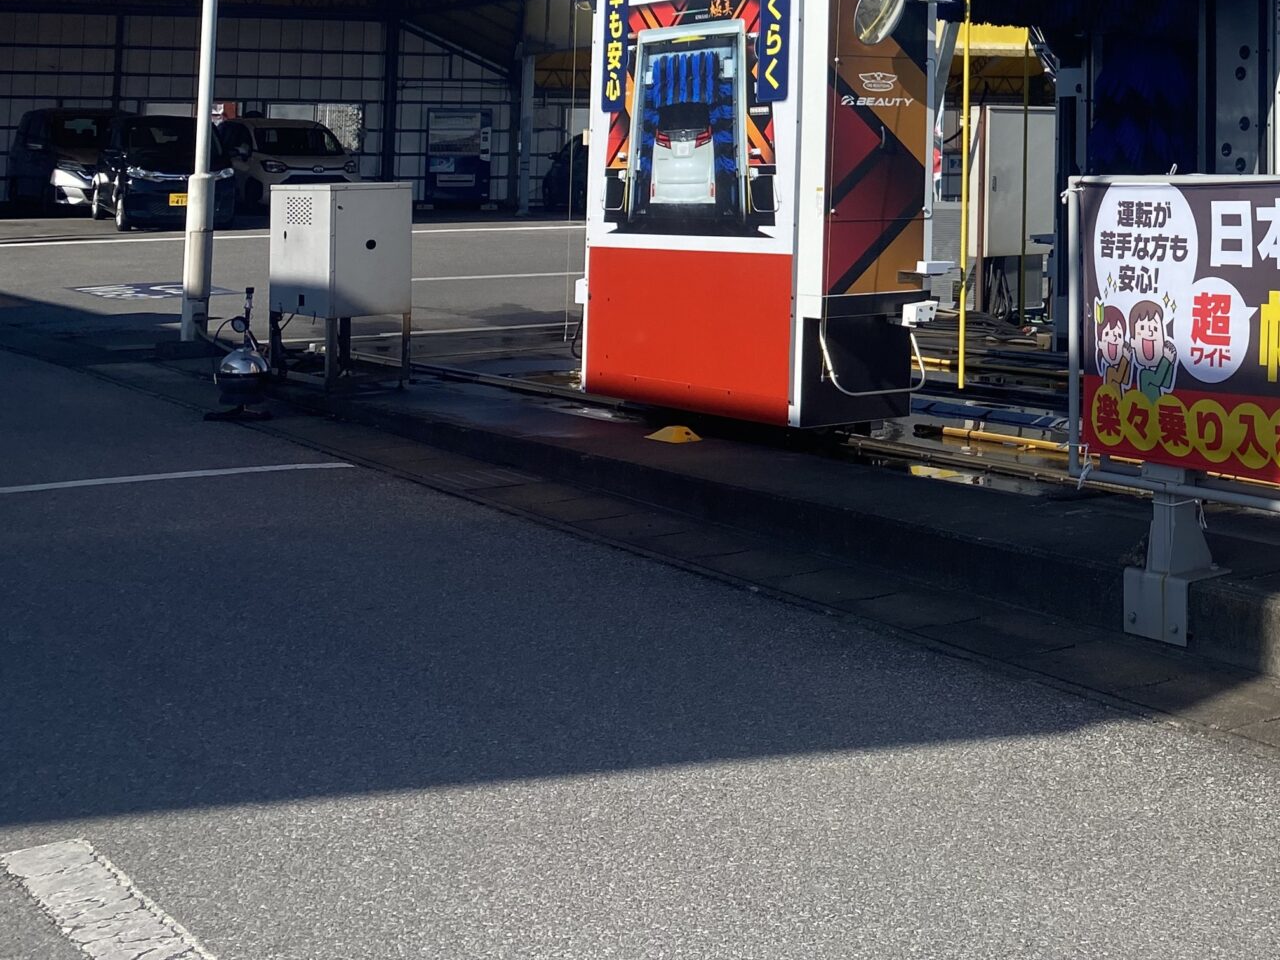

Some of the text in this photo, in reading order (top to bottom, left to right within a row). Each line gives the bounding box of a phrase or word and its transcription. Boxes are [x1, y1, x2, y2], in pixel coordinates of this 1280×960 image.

[856, 97, 914, 107] BEAUTY
[1116, 200, 1172, 230] 運転が
[1100, 230, 1189, 261] 苦手な方も
[1118, 265, 1160, 294] 安心!
[1190, 292, 1232, 347] 超
[1190, 347, 1232, 368] ワイド
